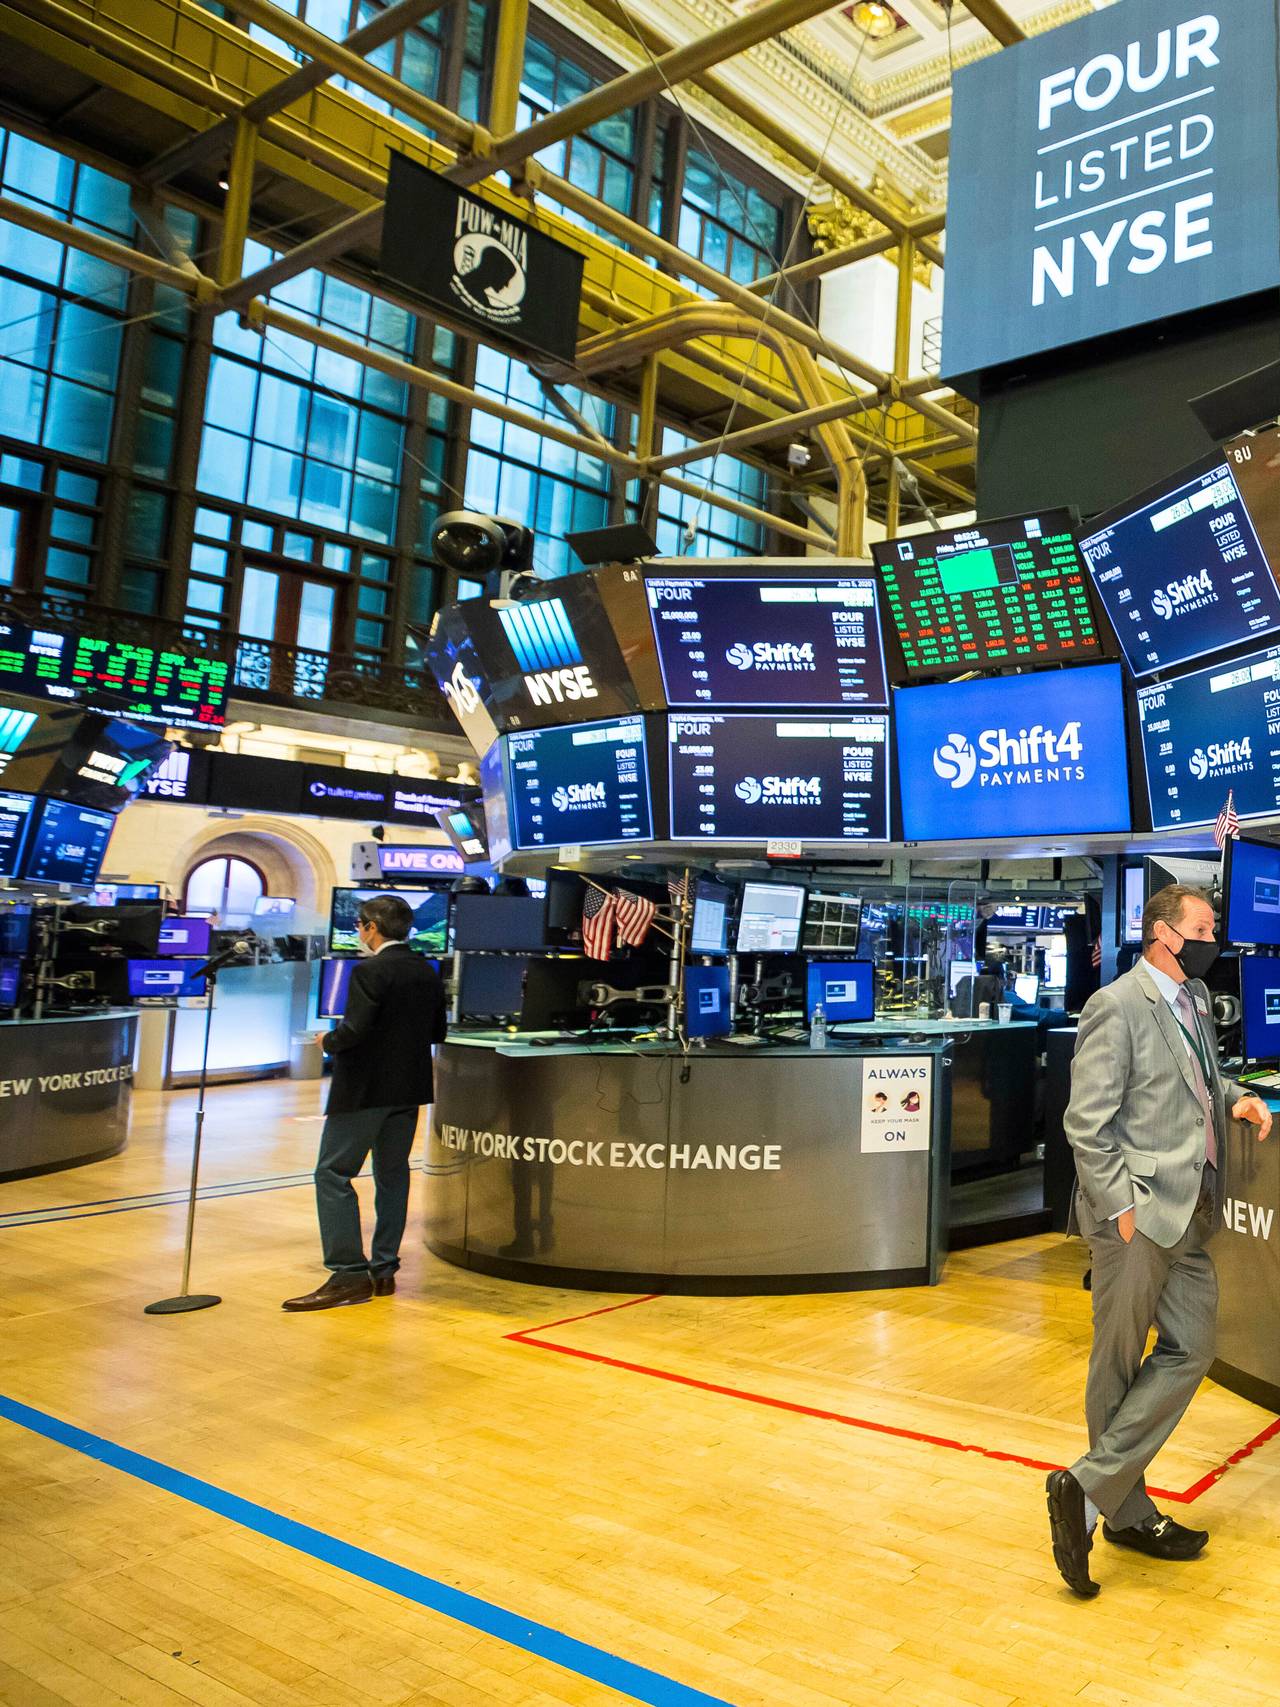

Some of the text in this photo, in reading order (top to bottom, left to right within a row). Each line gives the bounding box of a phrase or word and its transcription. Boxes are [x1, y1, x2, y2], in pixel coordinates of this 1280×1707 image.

[1038, 14, 1220, 130] FOUR
[1035, 114, 1214, 209] LISTED
[1032, 192, 1213, 306] NYSE
[1234, 446, 1251, 464] 8U
[1209, 512, 1236, 532] FOUR
[1216, 530, 1241, 547] LISTED
[1088, 542, 1112, 563] FOUR
[1222, 544, 1248, 563] NYSE
[656, 588, 692, 600] FOUR
[1166, 568, 1214, 605] Shift4
[1174, 592, 1219, 617] PAYMENTS
[832, 612, 864, 622] FOUR
[834, 625, 864, 634] LISTED
[836, 637, 866, 648] NYSE
[754, 642, 814, 662] Shift4
[755, 662, 816, 672] PAYMENTS
[524, 665, 599, 706] NYSE
[1144, 694, 1166, 711] FOUR
[678, 723, 711, 735] FOUR
[514, 740, 535, 751] FOUR
[843, 747, 874, 757] FOUR
[978, 721, 1083, 768] Shift4
[1207, 736, 1252, 766] Shift4
[616, 749, 637, 760] FOUR
[617, 762, 636, 770] LISTED
[844, 760, 872, 769] LISTED
[1209, 762, 1254, 778] PAYMENTS
[618, 774, 638, 783] NYSE
[844, 772, 873, 782] NYSE
[980, 766, 1085, 787] PAYMENTS
[147, 780, 186, 796] YSE
[568, 782, 606, 803] Shift4
[762, 776, 822, 796] Shift4
[568, 801, 607, 810] PAYMENTS
[762, 796, 822, 804] PAYMENTS
[771, 842, 798, 851] 2330
[384, 852, 463, 870] LIVE ON
[868, 1068, 926, 1079] ALWAYS
[0, 1079, 32, 1098] EW
[38, 1072, 82, 1092] YORK
[84, 1068, 118, 1086] STOCK
[884, 1131, 906, 1142] ON
[441, 1124, 782, 1170] NEW YORK STOCK EXCHANGE
